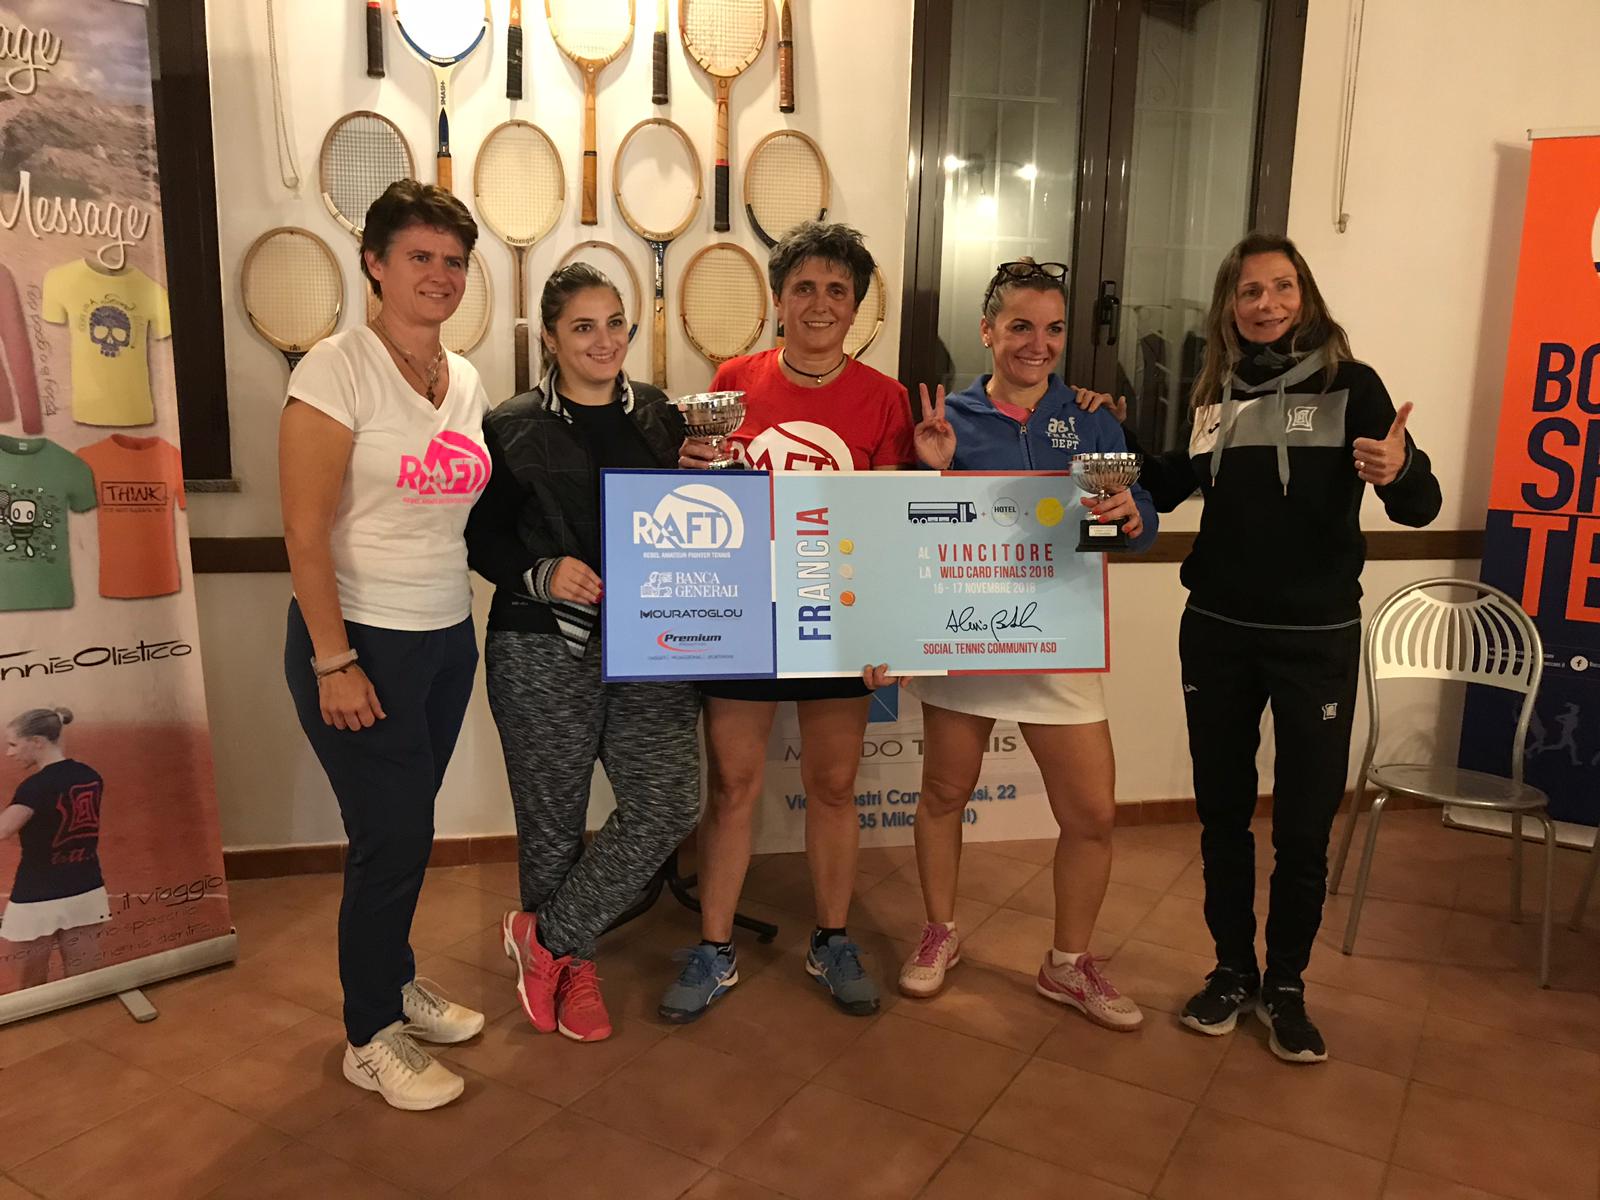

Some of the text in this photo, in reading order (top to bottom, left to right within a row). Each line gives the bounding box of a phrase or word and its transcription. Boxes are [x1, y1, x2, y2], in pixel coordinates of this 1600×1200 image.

[1051, 438, 1080, 451] DEPT
[994, 505, 1017, 513] HOTEL
[632, 510, 725, 545] RAFT
[918, 543, 1054, 563] AL VINCITORE
[675, 571, 720, 585] BANCA
[795, 506, 832, 641] FRANCIA
[919, 565, 1055, 579] LA WILD CARD FINALS 2018
[674, 585, 739, 599] GENERALI
[953, 582, 964, 594] 17
[965, 582, 1012, 594] NOVEMBRE
[639, 608, 743, 620] MOURATOGLOU
[664, 633, 722, 643] Premium
[923, 641, 1057, 655] SOCIAL TENNIS COMMUNITY ASD
[996, 783, 1017, 800] 22
[136, 874, 224, 908] viaggio
